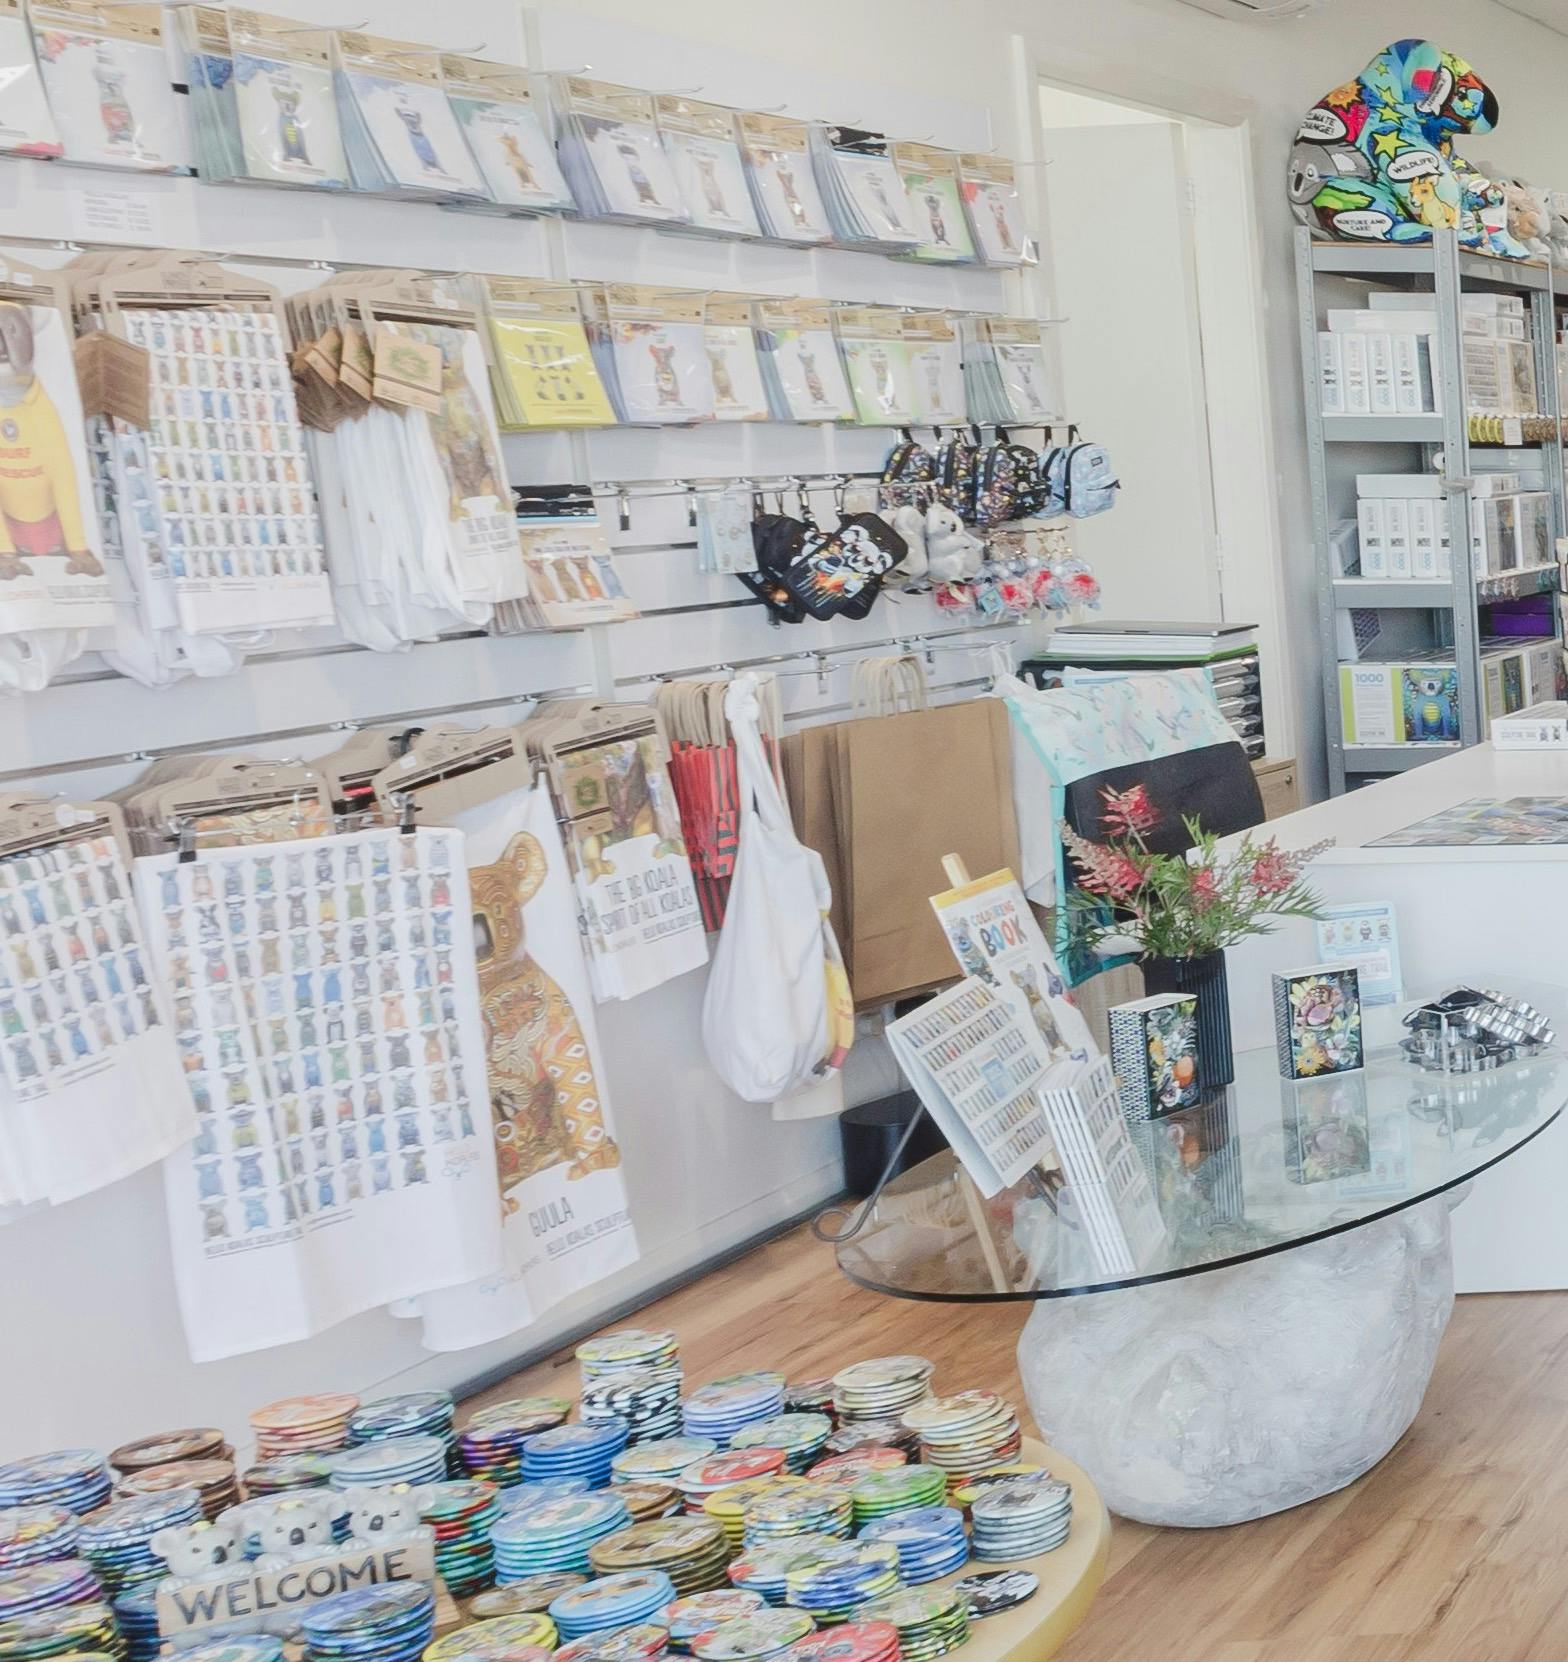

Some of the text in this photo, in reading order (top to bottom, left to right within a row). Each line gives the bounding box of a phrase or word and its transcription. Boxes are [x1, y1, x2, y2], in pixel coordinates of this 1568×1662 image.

[1354, 673, 1384, 683] 1000
[979, 914, 1029, 958] BOOK
[172, 1548, 412, 1625] WELCOME
